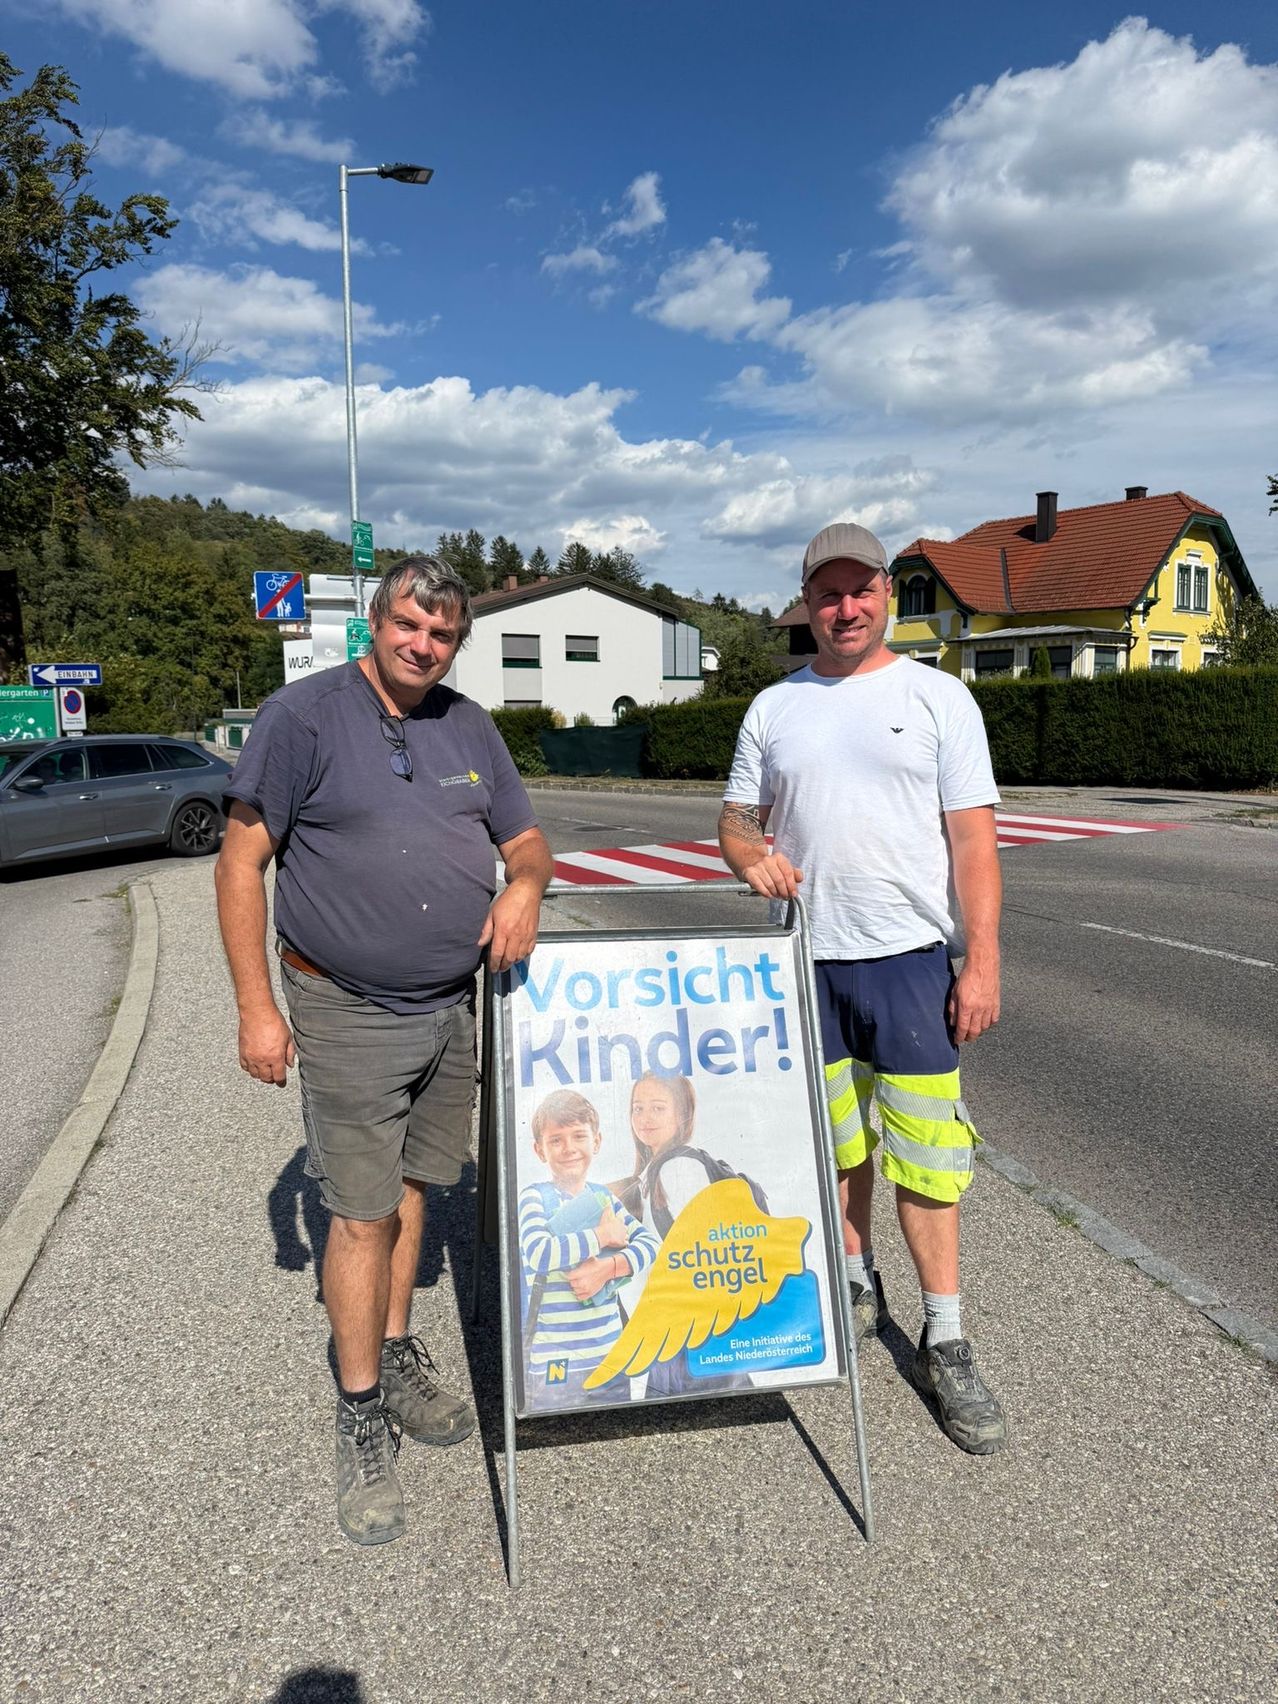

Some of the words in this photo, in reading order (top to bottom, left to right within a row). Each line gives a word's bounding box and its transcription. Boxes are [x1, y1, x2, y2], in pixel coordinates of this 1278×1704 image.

[57, 670, 94, 679] EINBAHN
[514, 946, 785, 1012] Vorsicht
[518, 1006, 793, 1087] Kinder!
[708, 1222, 767, 1241] aktion
[668, 1242, 755, 1270] schutz
[692, 1258, 768, 1294] engel
[730, 1338, 750, 1349] Eine
[752, 1335, 793, 1346] Initiative
[795, 1332, 812, 1342] des
[699, 1354, 734, 1365] Landes
[735, 1343, 813, 1360] Niederösterreich
